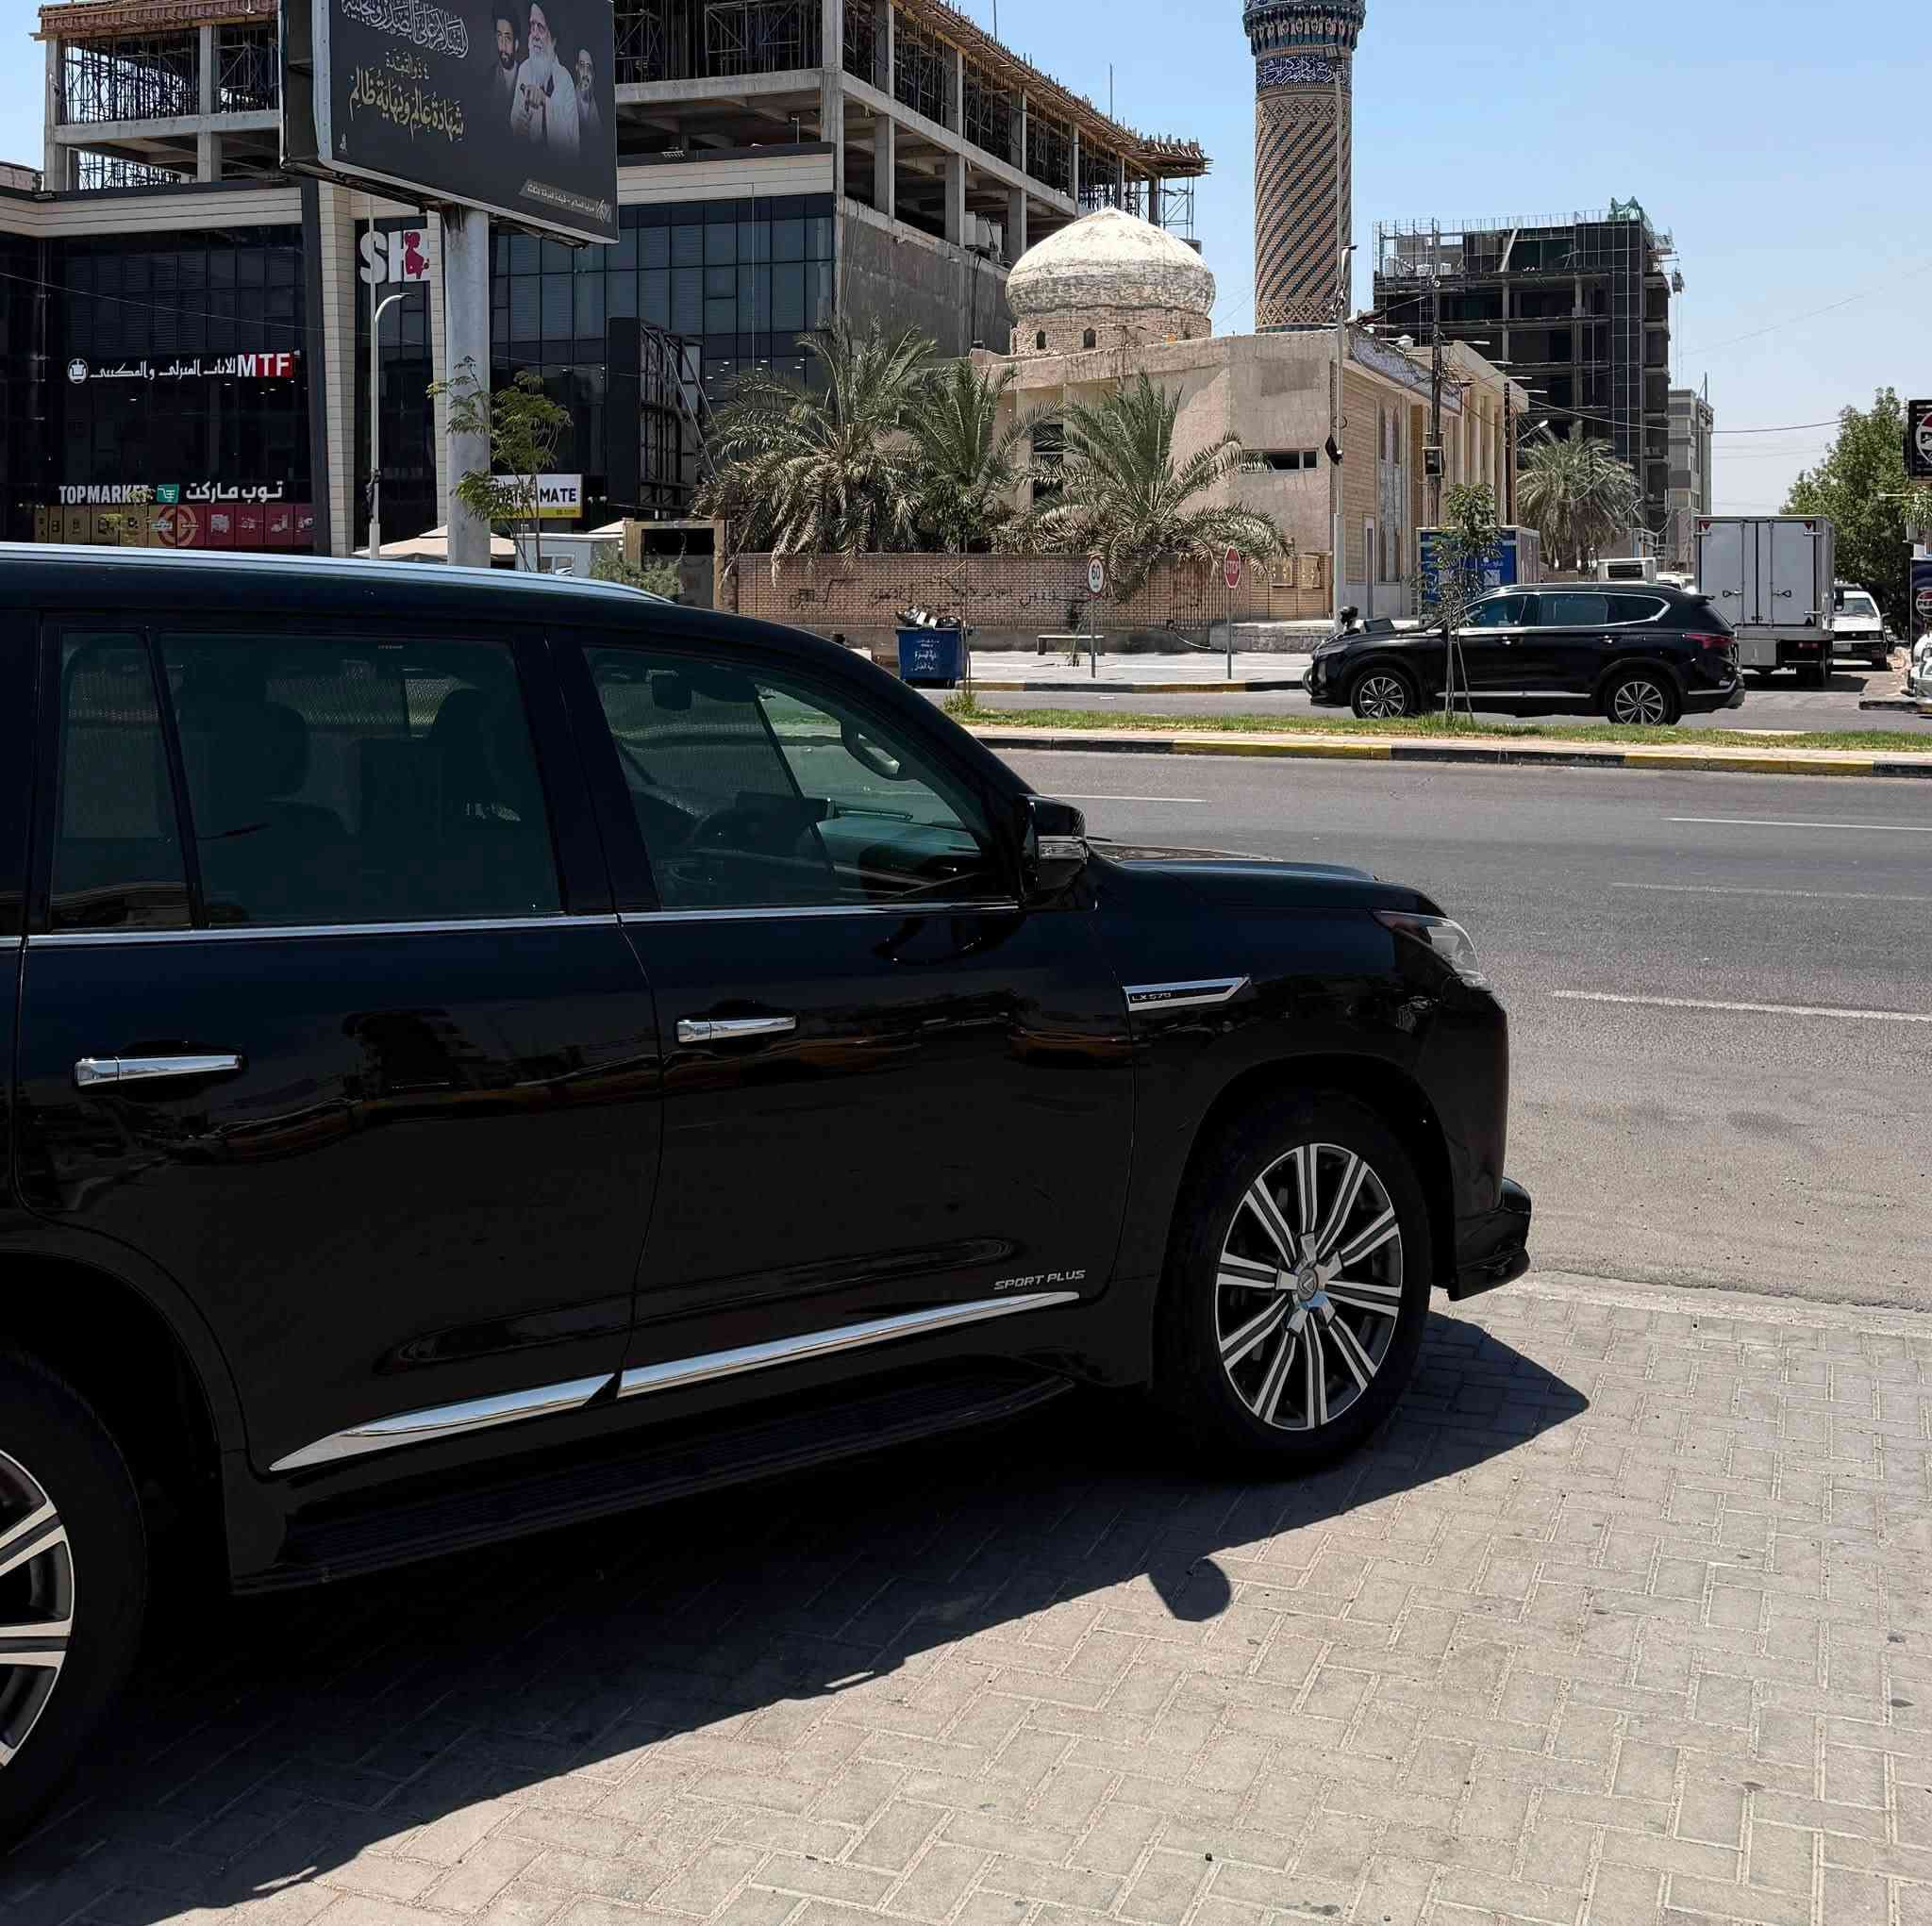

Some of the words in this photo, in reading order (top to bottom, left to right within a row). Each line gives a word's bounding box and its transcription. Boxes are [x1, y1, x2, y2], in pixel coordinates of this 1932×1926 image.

[237, 353, 291, 377] MTF
[186, 481, 239, 504] ماركت
[242, 480, 284, 504] توب
[1091, 564, 1101, 580] 60
[1226, 559, 1240, 574] STOP
[993, 1275, 1045, 1290] SPORT
[1046, 1270, 1086, 1283] PLUS
